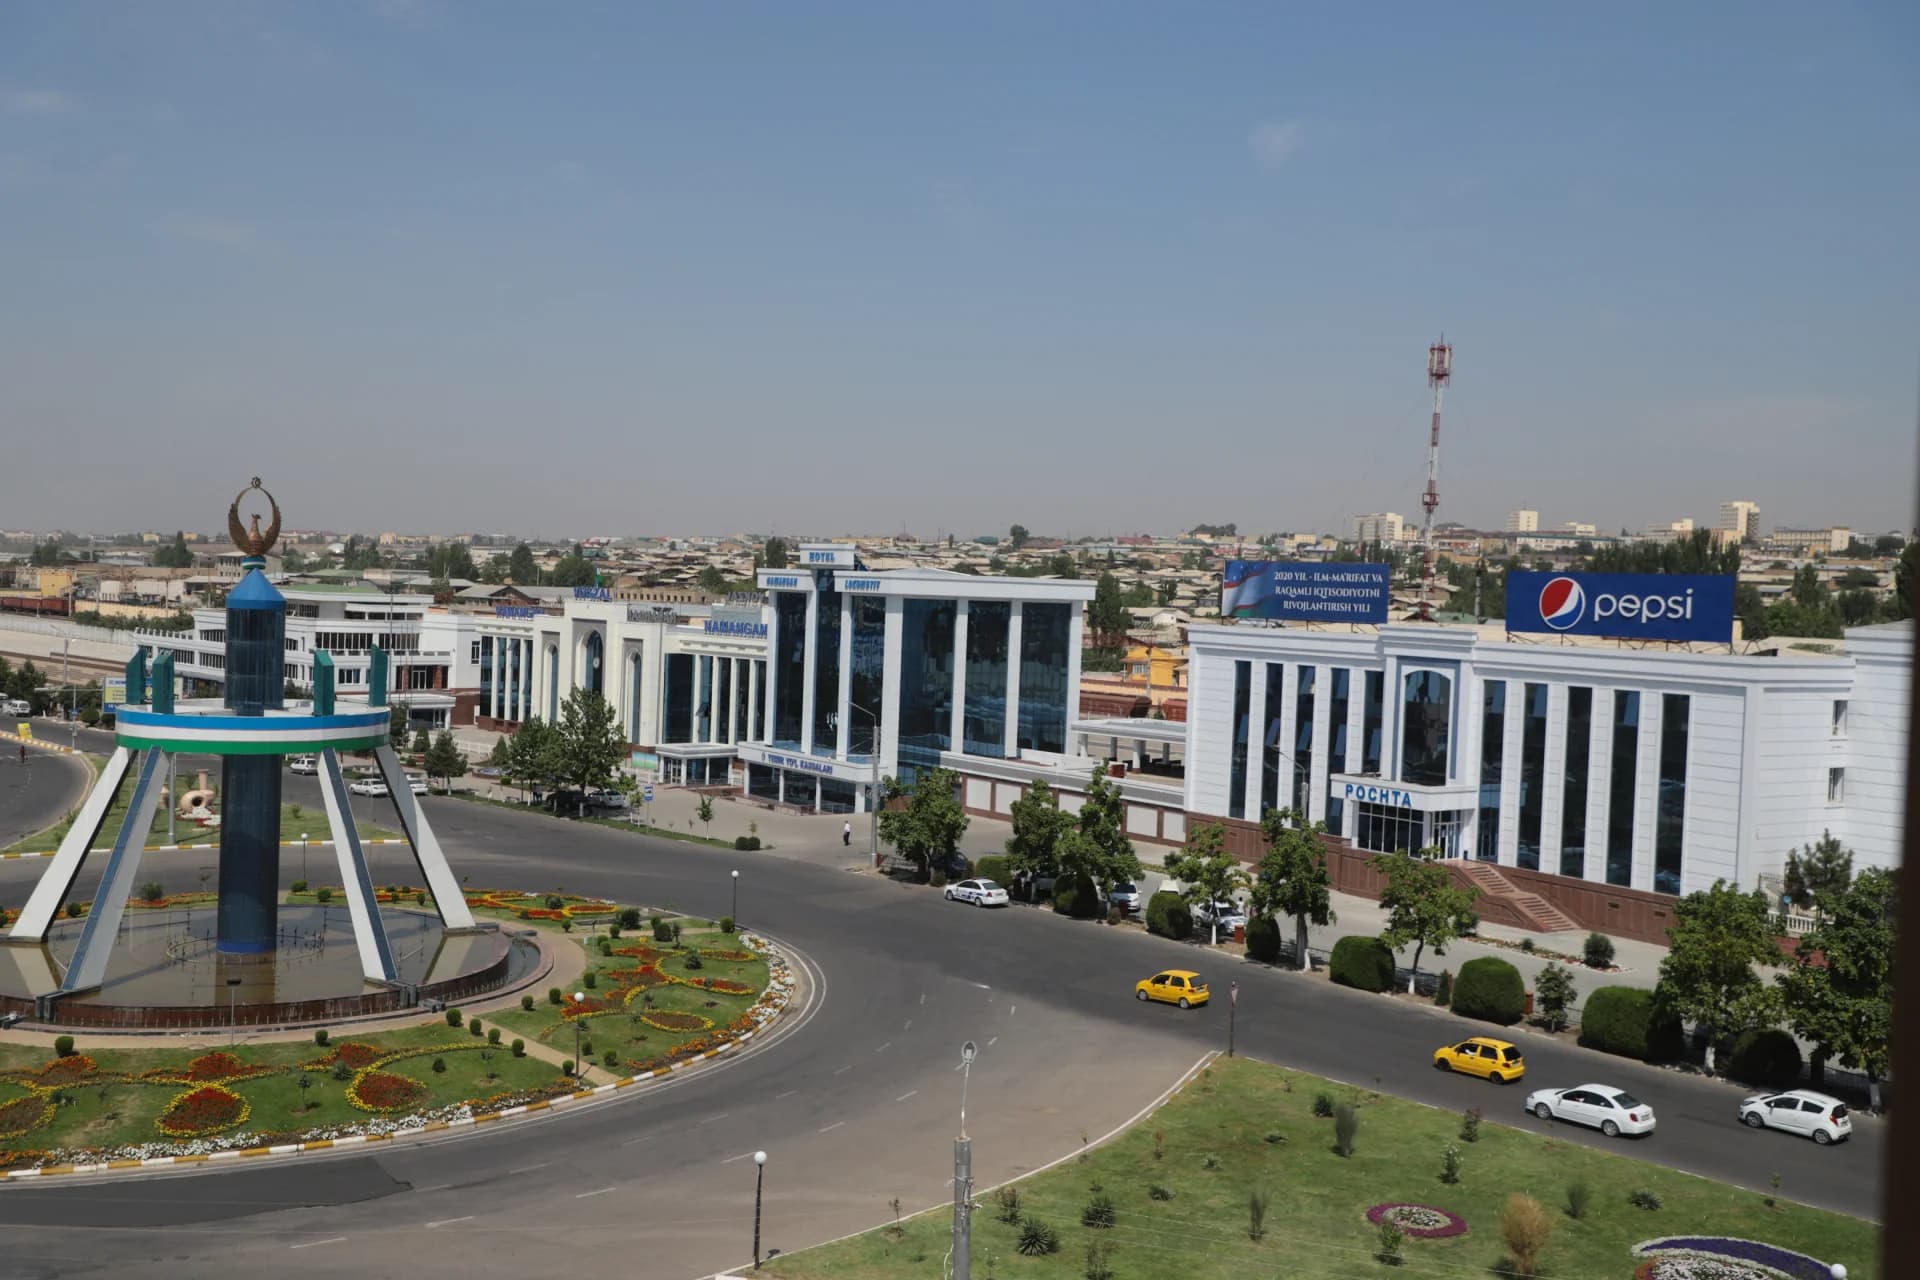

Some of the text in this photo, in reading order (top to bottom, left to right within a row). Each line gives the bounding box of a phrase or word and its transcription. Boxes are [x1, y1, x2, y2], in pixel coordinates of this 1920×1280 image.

[809, 552, 835, 563] HOTEL
[1273, 571, 1293, 581] 2020
[1294, 572, 1308, 581] YIL
[1371, 573, 1383, 583] VA
[1275, 586, 1380, 599] RAQAMLI IQTISODIYOTNI
[1283, 601, 1370, 613] RIVOJLANTIRISH YILI
[1593, 588, 1694, 624] pepsi
[704, 620, 768, 636] NAMANGAN
[1345, 783, 1412, 809] POCHTA
